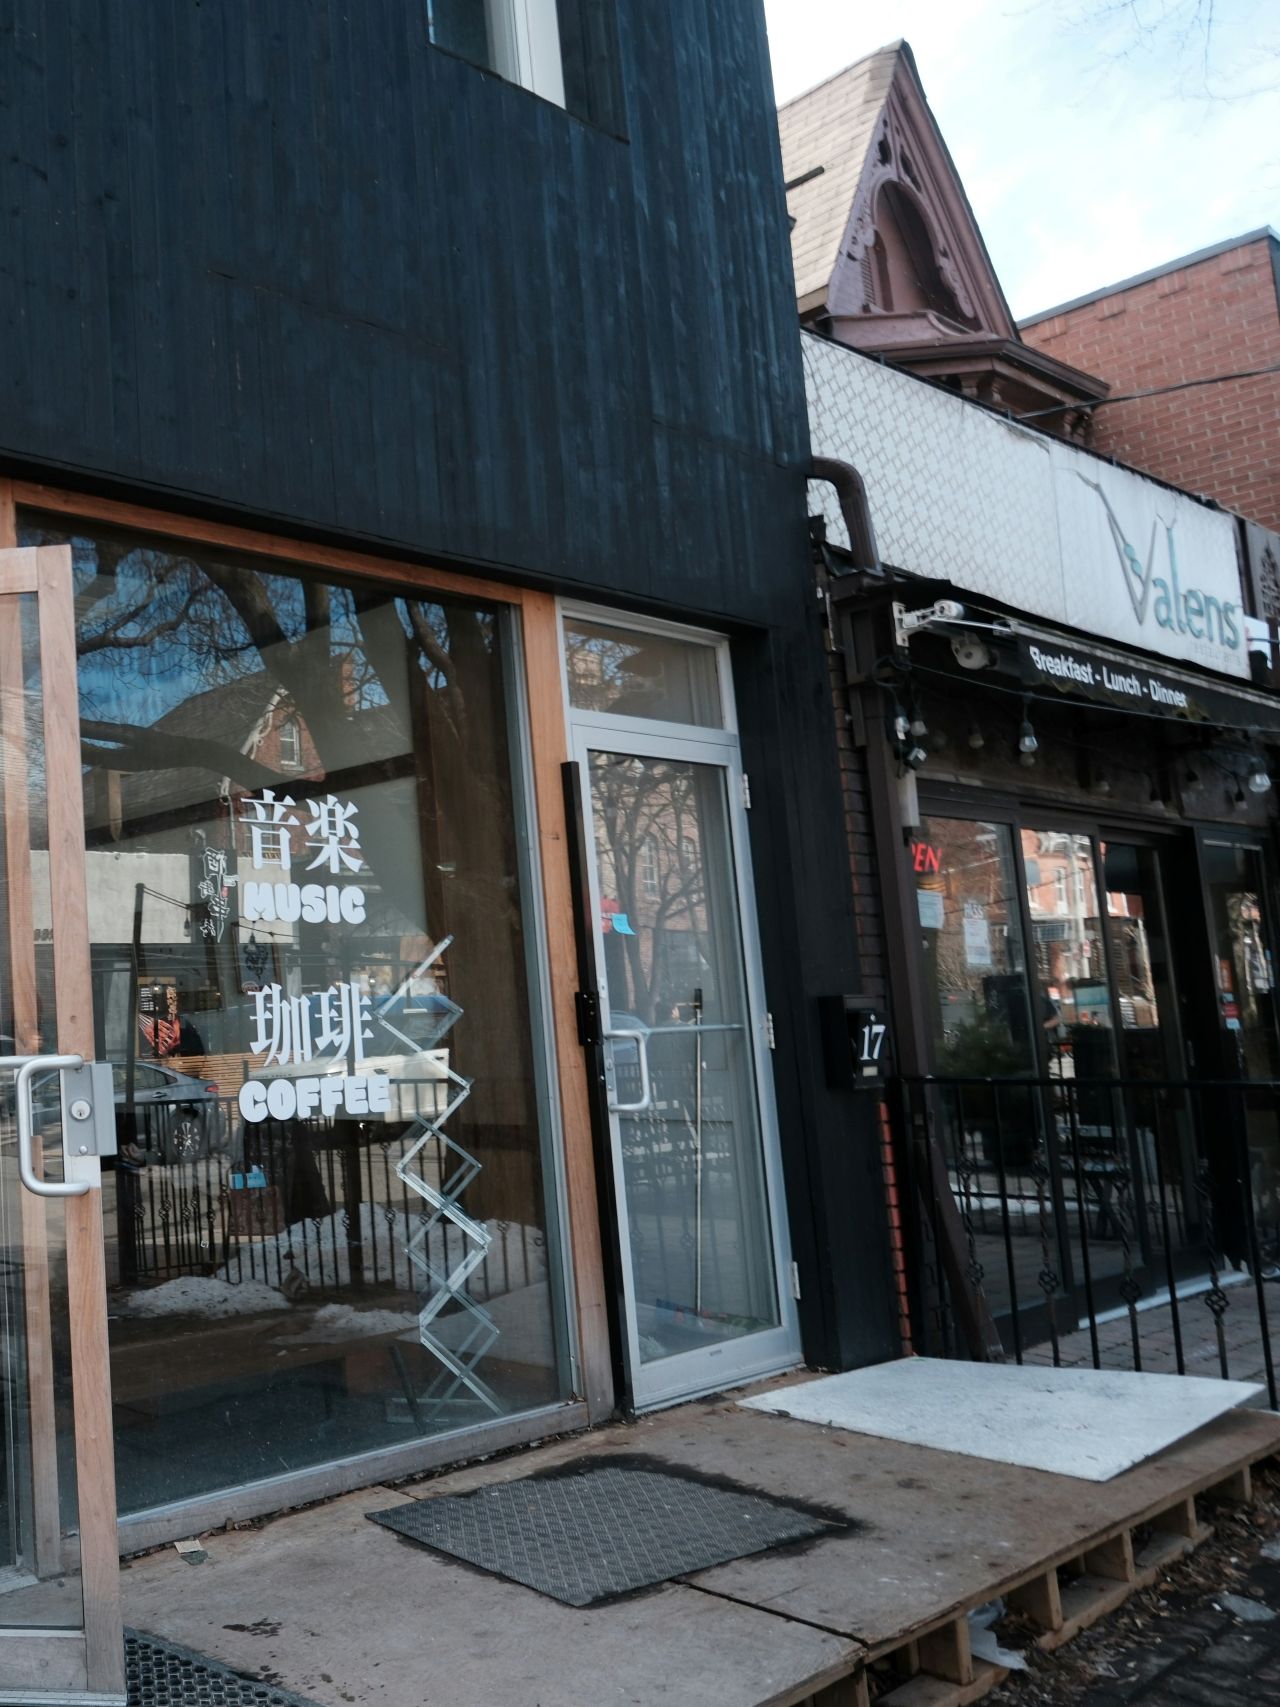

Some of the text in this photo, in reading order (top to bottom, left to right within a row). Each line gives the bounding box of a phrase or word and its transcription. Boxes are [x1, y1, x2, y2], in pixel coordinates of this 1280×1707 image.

[1076, 471, 1241, 651] Valens
[1029, 644, 1095, 685] Breakfast
[1102, 665, 1142, 697] Lunch
[1148, 678, 1188, 708] Dinner
[238, 788, 364, 875] 音楽
[243, 881, 367, 925] MUSIC
[247, 982, 375, 1067] 珈琲
[859, 1024, 886, 1060] 17
[238, 1073, 392, 1123] COFFEE
